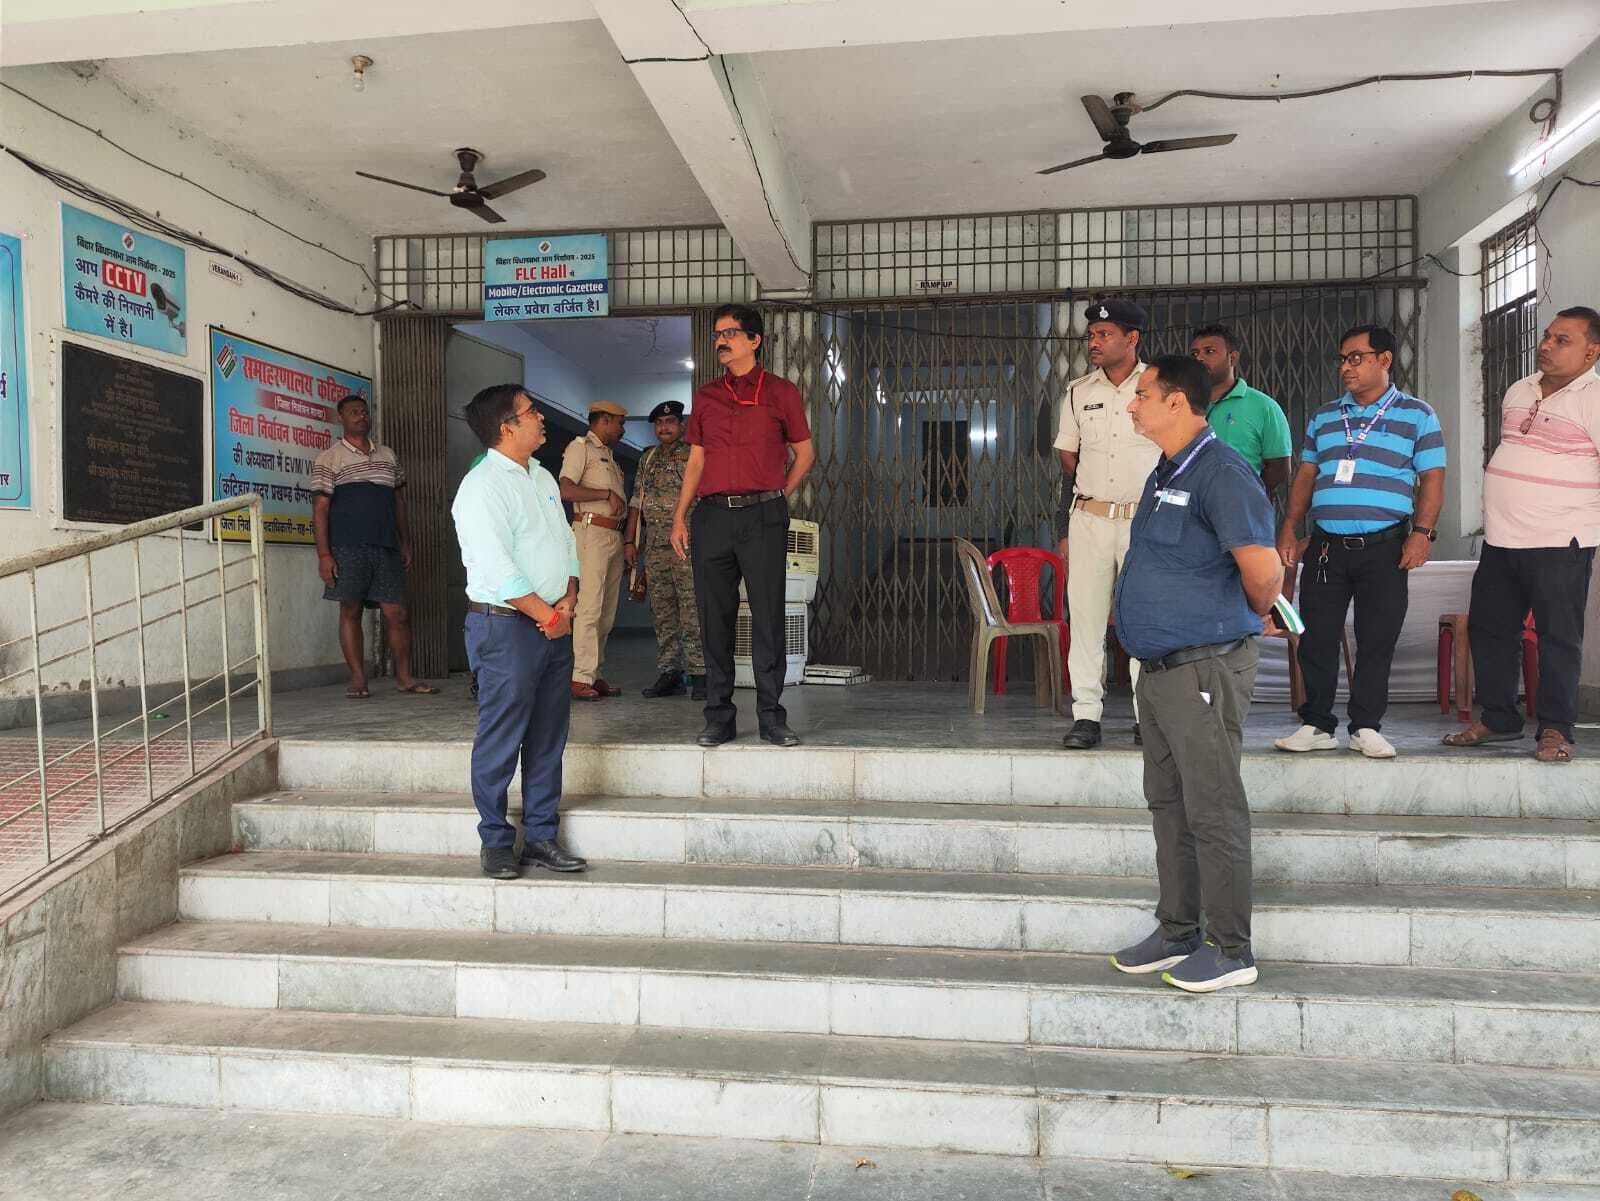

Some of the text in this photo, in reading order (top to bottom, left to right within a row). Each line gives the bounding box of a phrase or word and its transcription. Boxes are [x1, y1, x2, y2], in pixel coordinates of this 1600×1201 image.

[76, 235, 95, 251] बिहार
[95, 240, 125, 261] विधानसभा
[125, 252, 137, 267] आम
[137, 256, 158, 273] निर्वाचन
[162, 267, 177, 280] 2025
[496, 256, 512, 265] बिहार
[512, 255, 540, 265] विधानसभा
[554, 253, 575, 262] निर्वाचन
[580, 253, 595, 261] 2025
[75, 257, 144, 295] आप CCTV
[515, 265, 537, 281] FLC
[541, 264, 567, 280] Hall
[488, 282, 603, 298] Mobile/Electronic Gazettee
[921, 281, 940, 289] RAMP
[74, 282, 155, 321] कैमरे की निगरानी
[493, 302, 521, 317] लेकर
[524, 300, 550, 315] प्रवेश
[553, 297, 583, 314] वर्जित
[104, 315, 117, 333] में
[242, 356, 313, 395] समाहरणालय
[230, 407, 331, 450] जिला निर्वाचन पदाधिकारी
[233, 442, 243, 465] की
[245, 450, 275, 471] अध्यक्षता
